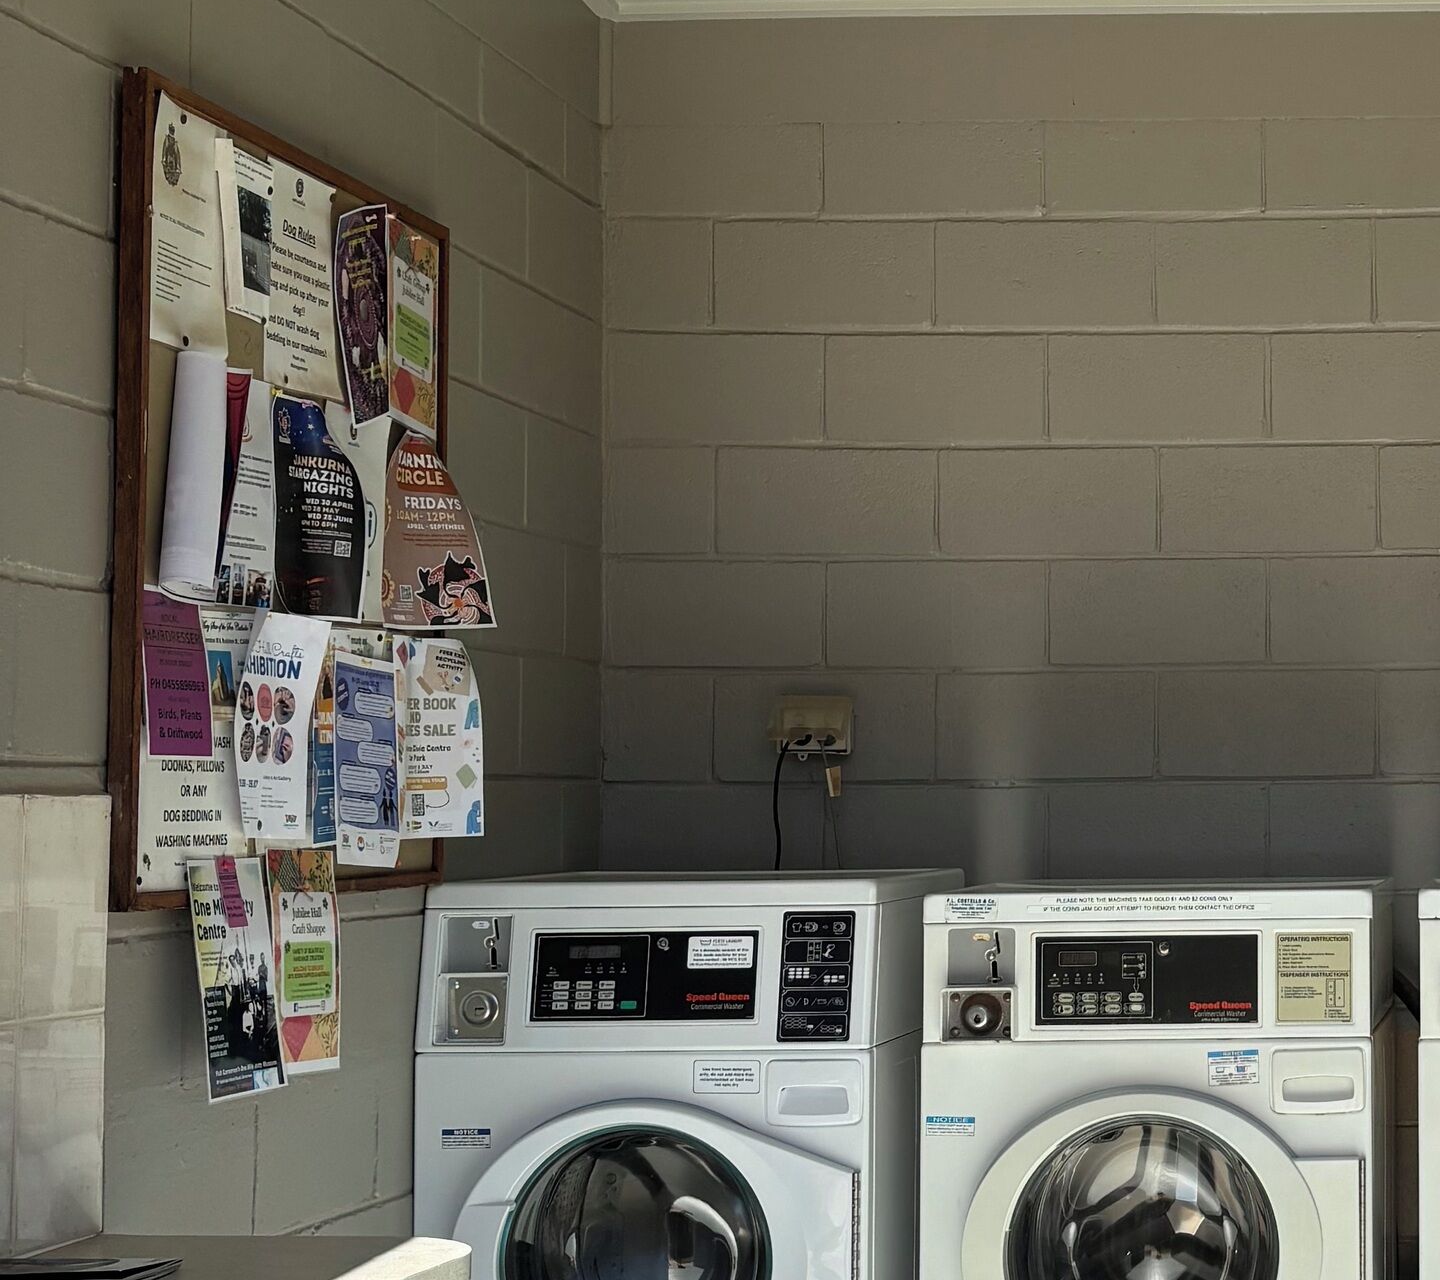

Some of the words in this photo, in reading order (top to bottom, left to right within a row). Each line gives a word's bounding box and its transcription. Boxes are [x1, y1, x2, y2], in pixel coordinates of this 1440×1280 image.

[283, 219, 296, 237] Dog
[298, 226, 316, 245] Rules
[288, 248, 293, 259] be
[294, 254, 316, 269] courteous
[318, 263, 326, 272] and
[282, 266, 292, 276] sure
[294, 271, 302, 279] you
[280, 283, 288, 291] and
[290, 287, 298, 296] pick
[300, 291, 305, 299] up
[306, 293, 317, 303] after
[318, 299, 329, 307] your
[277, 316, 284, 326] DO
[286, 319, 295, 330] NOT
[296, 325, 309, 334] wash
[310, 328, 319, 340] dog
[266, 330, 286, 346] bedding
[287, 337, 291, 346] in
[292, 341, 300, 349] our
[294, 454, 352, 476] JANKURNA
[398, 449, 444, 469] YARNIN
[289, 466, 353, 487] STARGAZING
[396, 468, 444, 486] CIRCLE
[304, 481, 354, 499] NIGHTS
[332, 501, 353, 510] APRIL
[405, 496, 462, 510] FRIDAYS
[322, 506, 340, 514] MAY
[427, 512, 455, 521] 12PM
[334, 514, 353, 524] JUNE
[144, 628, 200, 644] HAIRDRESSER
[272, 642, 304, 659] Crafts
[439, 649, 453, 657] FREE
[245, 655, 301, 680] HIBITION
[436, 656, 466, 666] RECYCLING
[438, 663, 463, 672] ACTIVITY
[150, 679, 161, 688] PH
[423, 698, 456, 710] BOOK
[158, 708, 179, 719] Birds,
[181, 709, 202, 720] Plants
[410, 712, 421, 723] ND
[159, 727, 166, 738] &
[168, 727, 203, 739] Driftwood
[423, 724, 456, 736] SALE
[162, 760, 194, 774] DOONAS,
[197, 761, 224, 772] PILLOWS
[180, 785, 190, 797] OR
[192, 785, 207, 797] ANY
[164, 810, 180, 822] DOG
[182, 810, 213, 821] BEDDING
[215, 810, 222, 821] IN
[156, 835, 190, 847] WASHING
[192, 834, 228, 847] MACHINES
[194, 899, 211, 916] One
[213, 898, 226, 918] Mil
[292, 907, 310, 921] Jubilee
[311, 907, 322, 918] Hall
[197, 924, 226, 940] Centre
[292, 924, 306, 934] Craft
[307, 924, 326, 936] Shoppe
[686, 993, 717, 1002] Speed
[719, 992, 750, 1000] Queen
[1189, 1002, 1219, 1010] Speed
[1222, 1001, 1252, 1009] Queen
